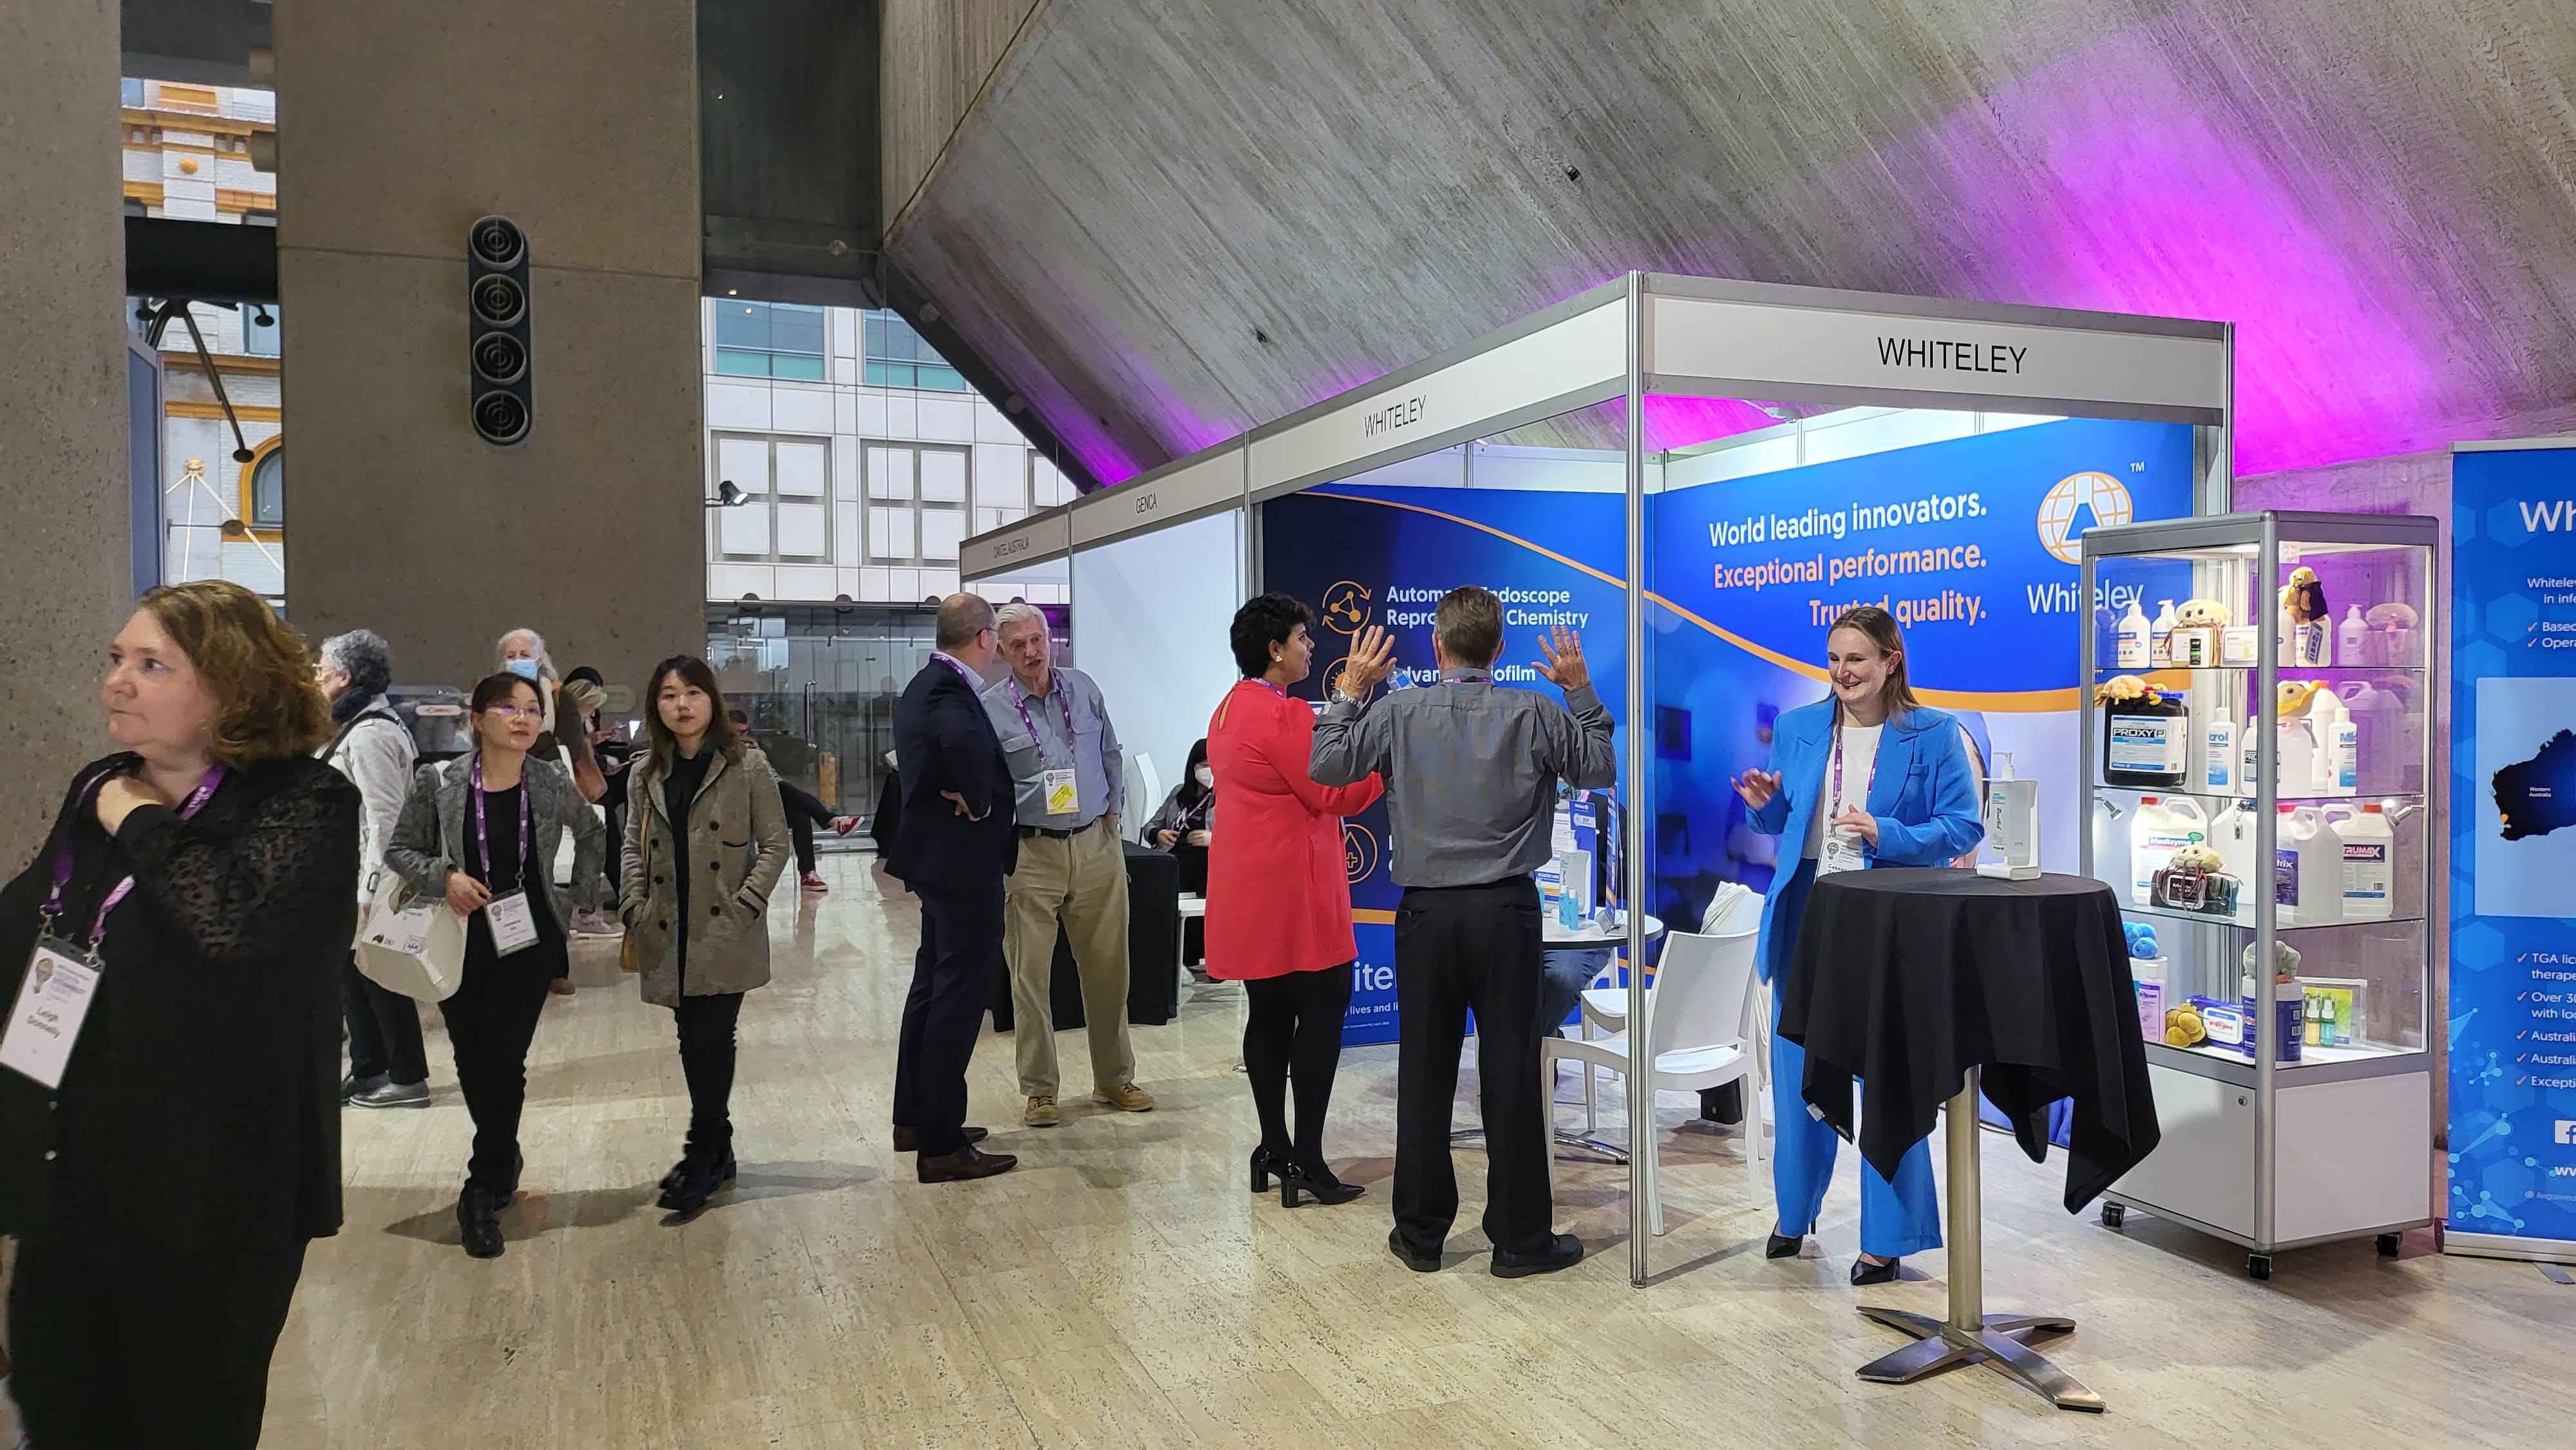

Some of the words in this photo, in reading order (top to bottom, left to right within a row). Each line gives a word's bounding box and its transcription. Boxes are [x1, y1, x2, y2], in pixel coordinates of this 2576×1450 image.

[1877, 337, 2027, 373] WHITELEY
[1365, 394, 1426, 438] WHITELEY
[2129, 461, 2145, 473] TM
[1136, 492, 1157, 514] GENCA
[1709, 516, 1765, 547] World
[1770, 509, 1846, 540] leading
[1852, 492, 1987, 531] innovators.
[1714, 554, 1823, 592] Exceptional
[1829, 544, 1987, 587] performance.
[2027, 579, 2145, 614] Whieley
[2544, 593, 2555, 604] in
[1506, 608, 1589, 628] Chemistry
[1896, 590, 1987, 630] quality.
[2531, 953, 2559, 964] TGA
[2562, 954, 2576, 965] lic
[2531, 992, 2562, 1003] Over
[1350, 1004, 1371, 1015] lives
[1373, 1003, 1391, 1013] and
[2531, 1008, 2558, 1019] with
[2531, 1030, 2576, 1042] Australi
[2531, 1053, 2576, 1065] Australi
